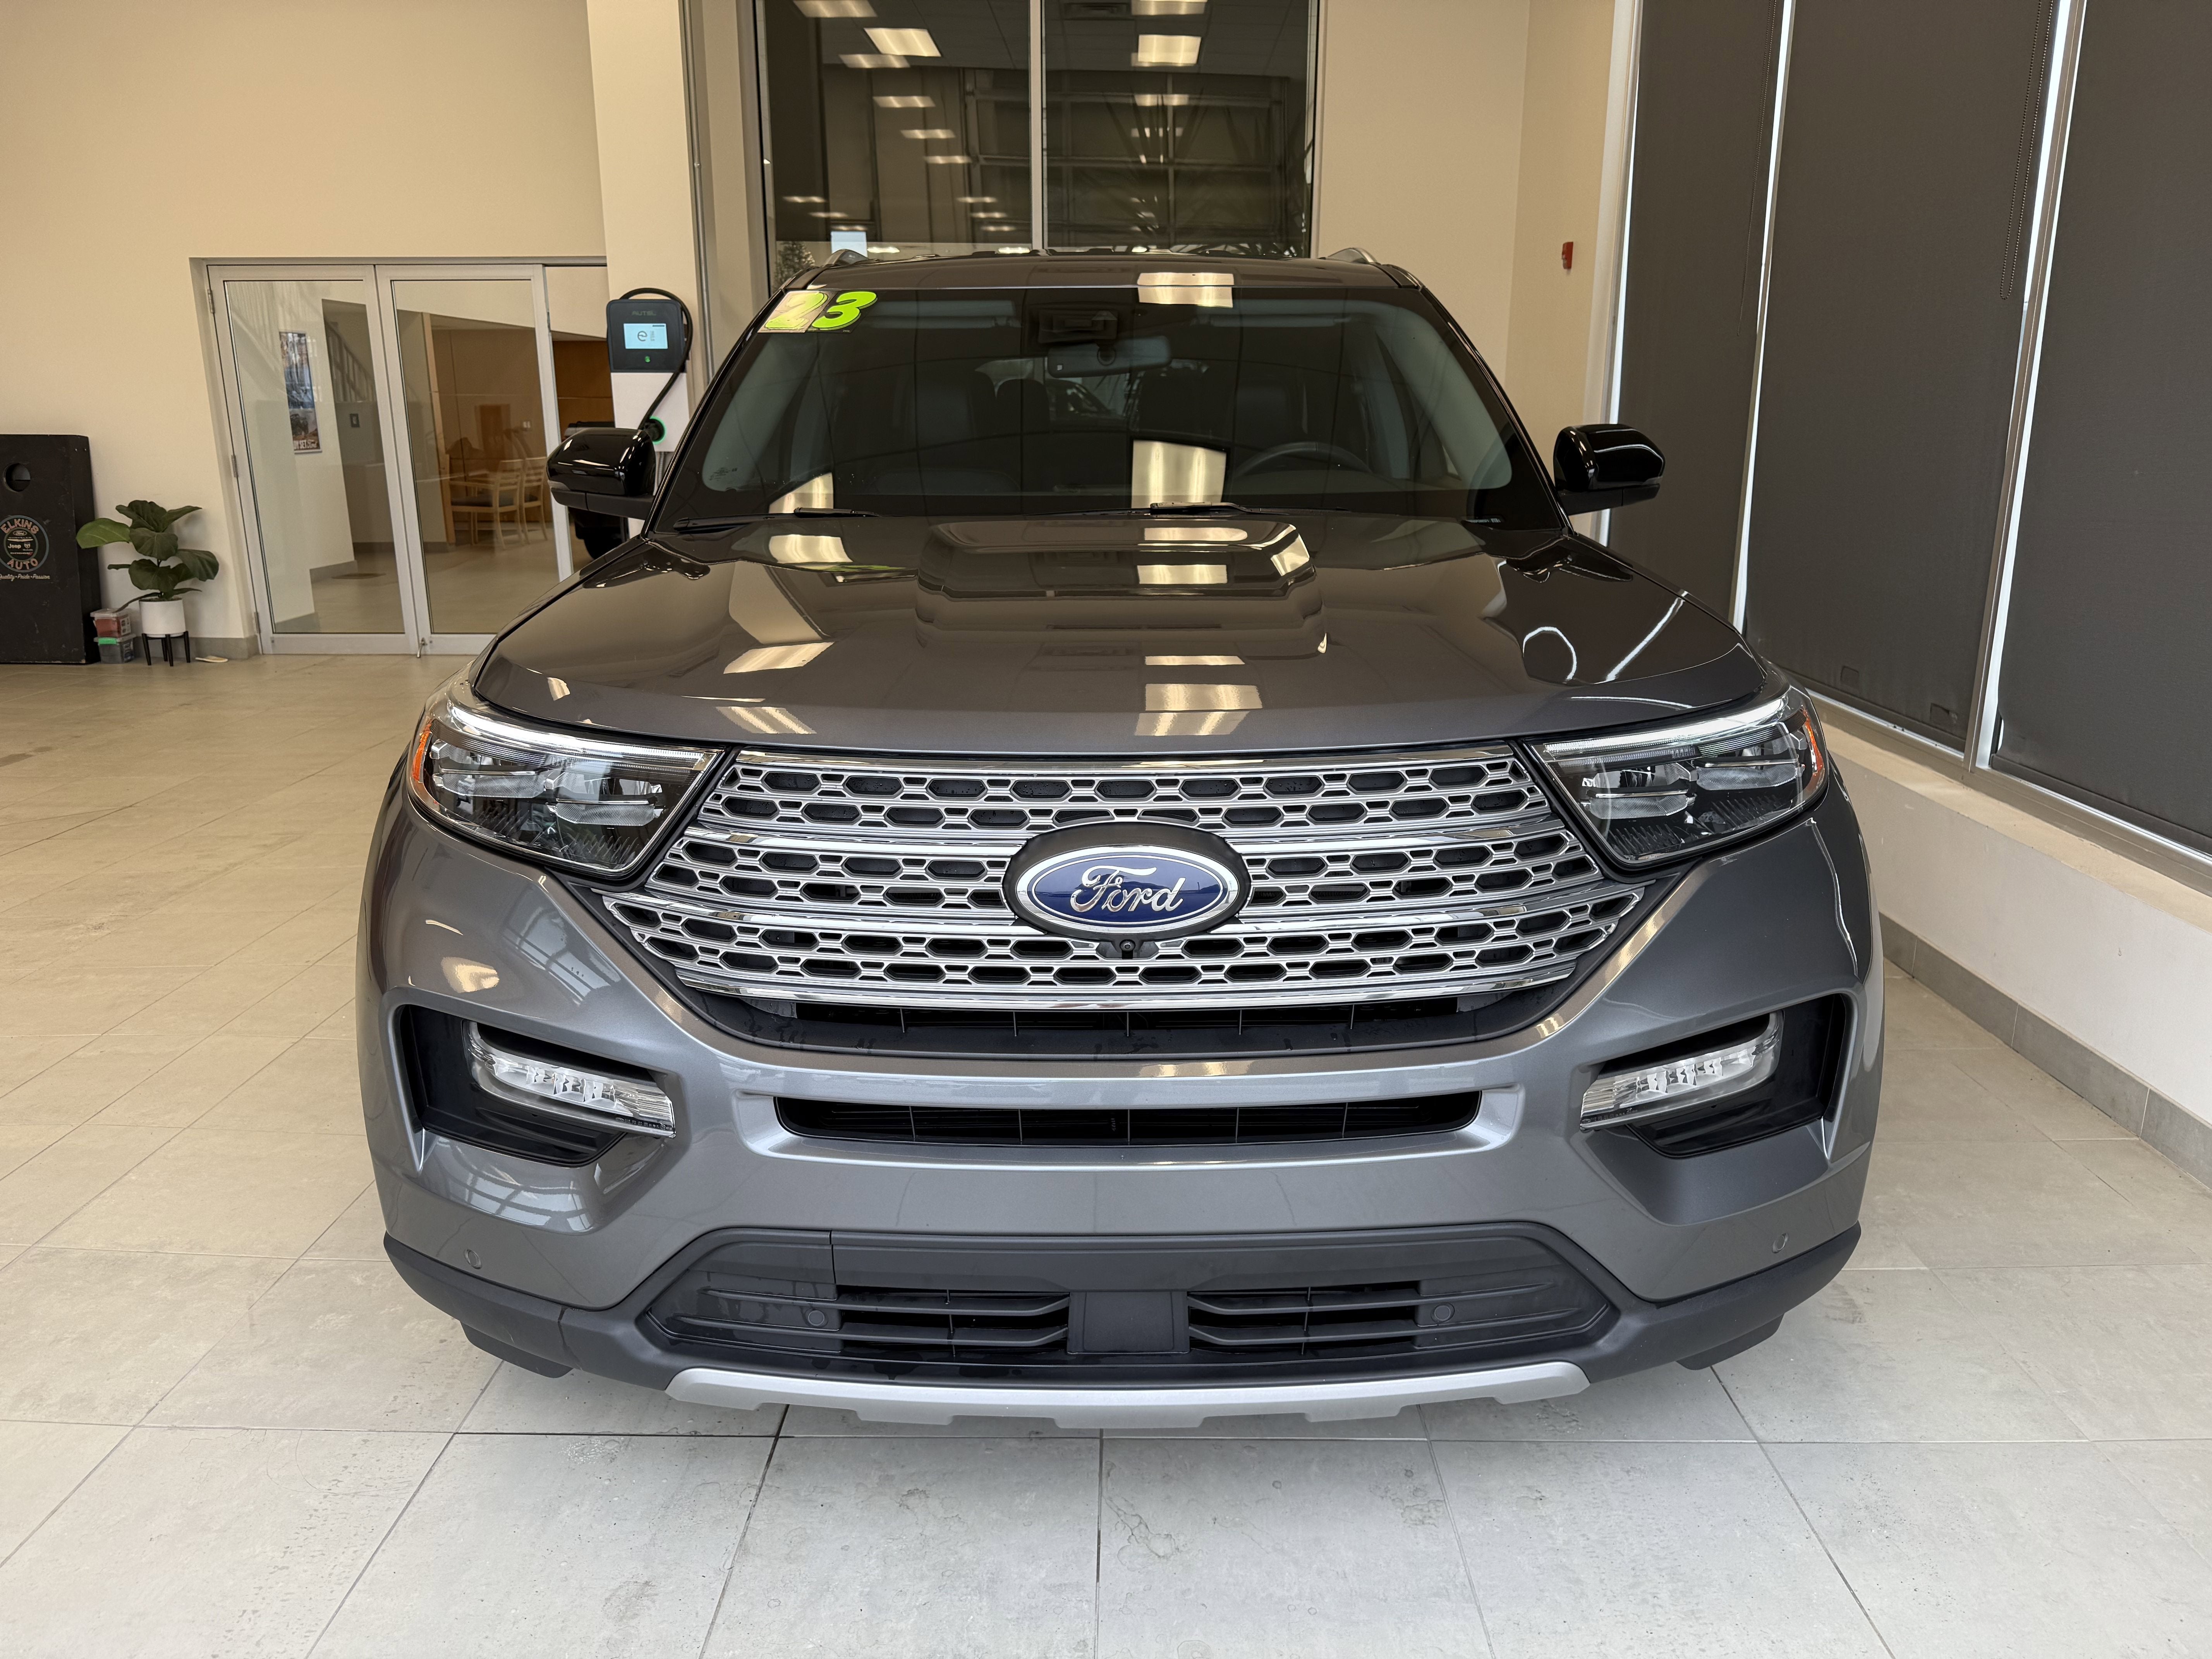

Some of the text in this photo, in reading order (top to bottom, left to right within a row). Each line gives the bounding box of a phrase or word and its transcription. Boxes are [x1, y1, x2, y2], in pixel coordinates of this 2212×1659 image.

[765, 291, 878, 330] 23
[0, 519, 39, 534] ELKINS
[7, 558, 38, 570] AUTO
[1070, 865, 1186, 912] Ford
